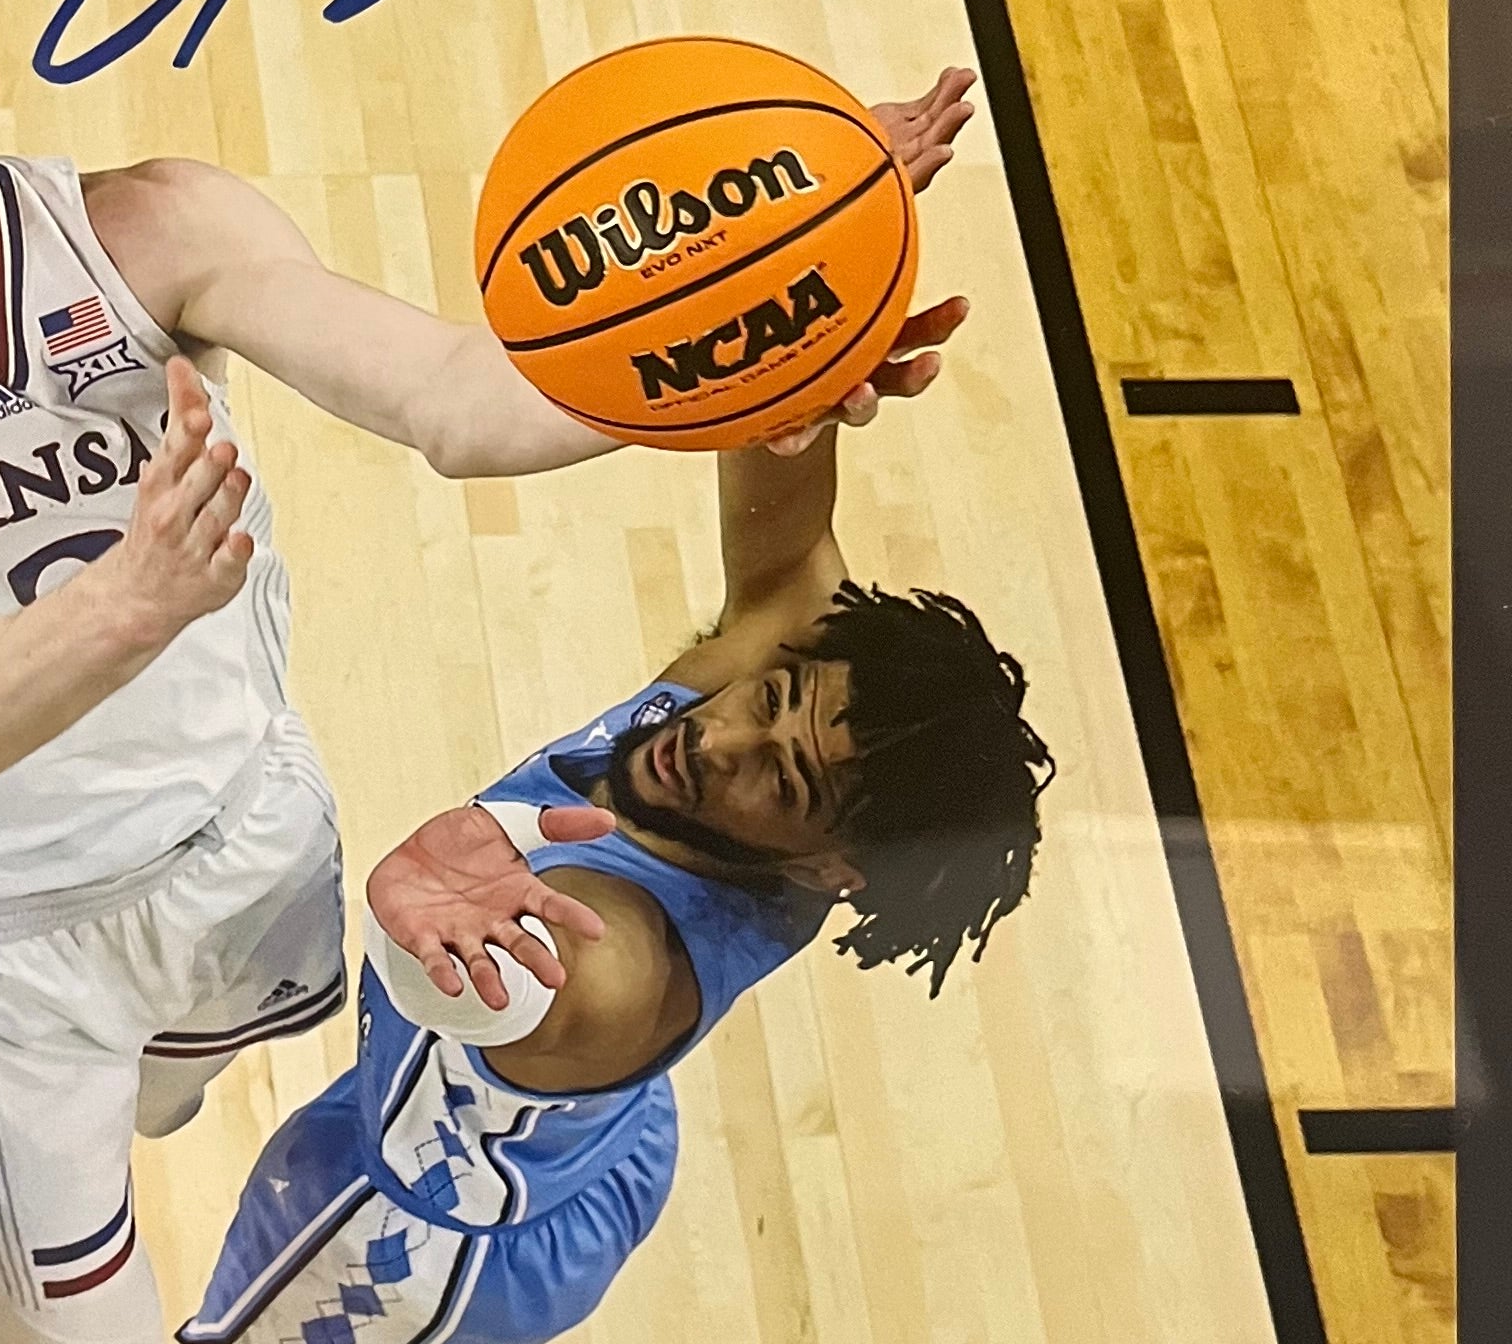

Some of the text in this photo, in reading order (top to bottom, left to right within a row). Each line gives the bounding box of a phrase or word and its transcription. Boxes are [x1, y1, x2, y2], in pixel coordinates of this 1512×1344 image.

[517, 147, 820, 310] Wilson
[640, 230, 728, 279] EVO NXT
[630, 265, 844, 400] NCAA
